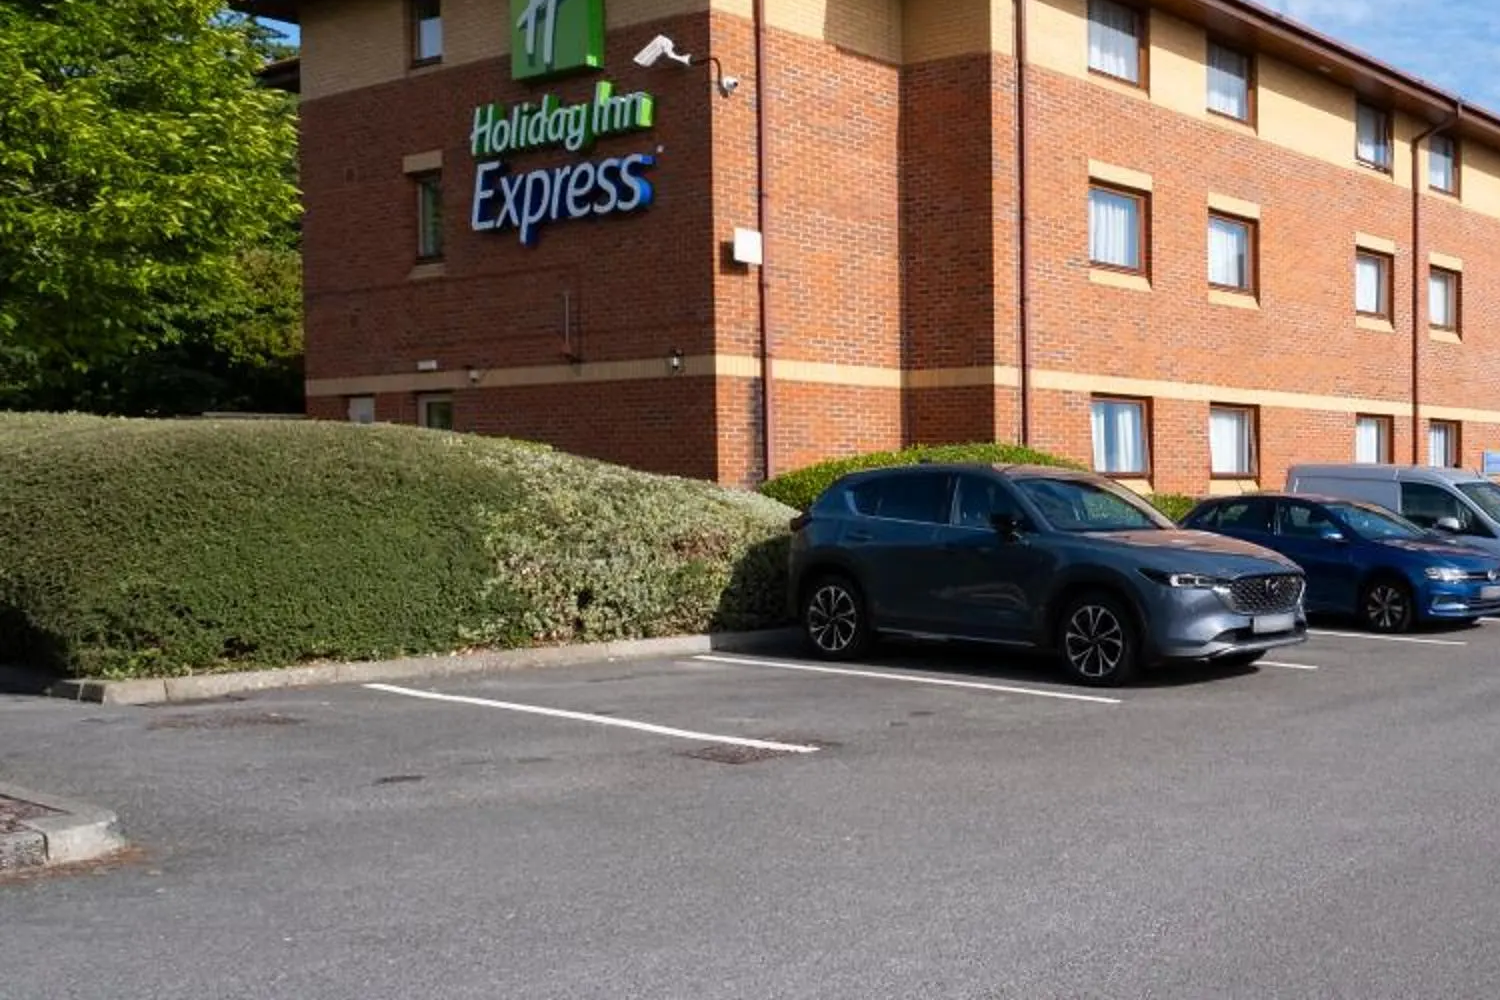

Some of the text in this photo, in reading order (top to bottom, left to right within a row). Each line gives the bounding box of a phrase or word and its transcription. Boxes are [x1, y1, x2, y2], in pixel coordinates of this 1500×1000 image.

[470, 80, 652, 156] Holiday Inn
[471, 153, 653, 244] Express
